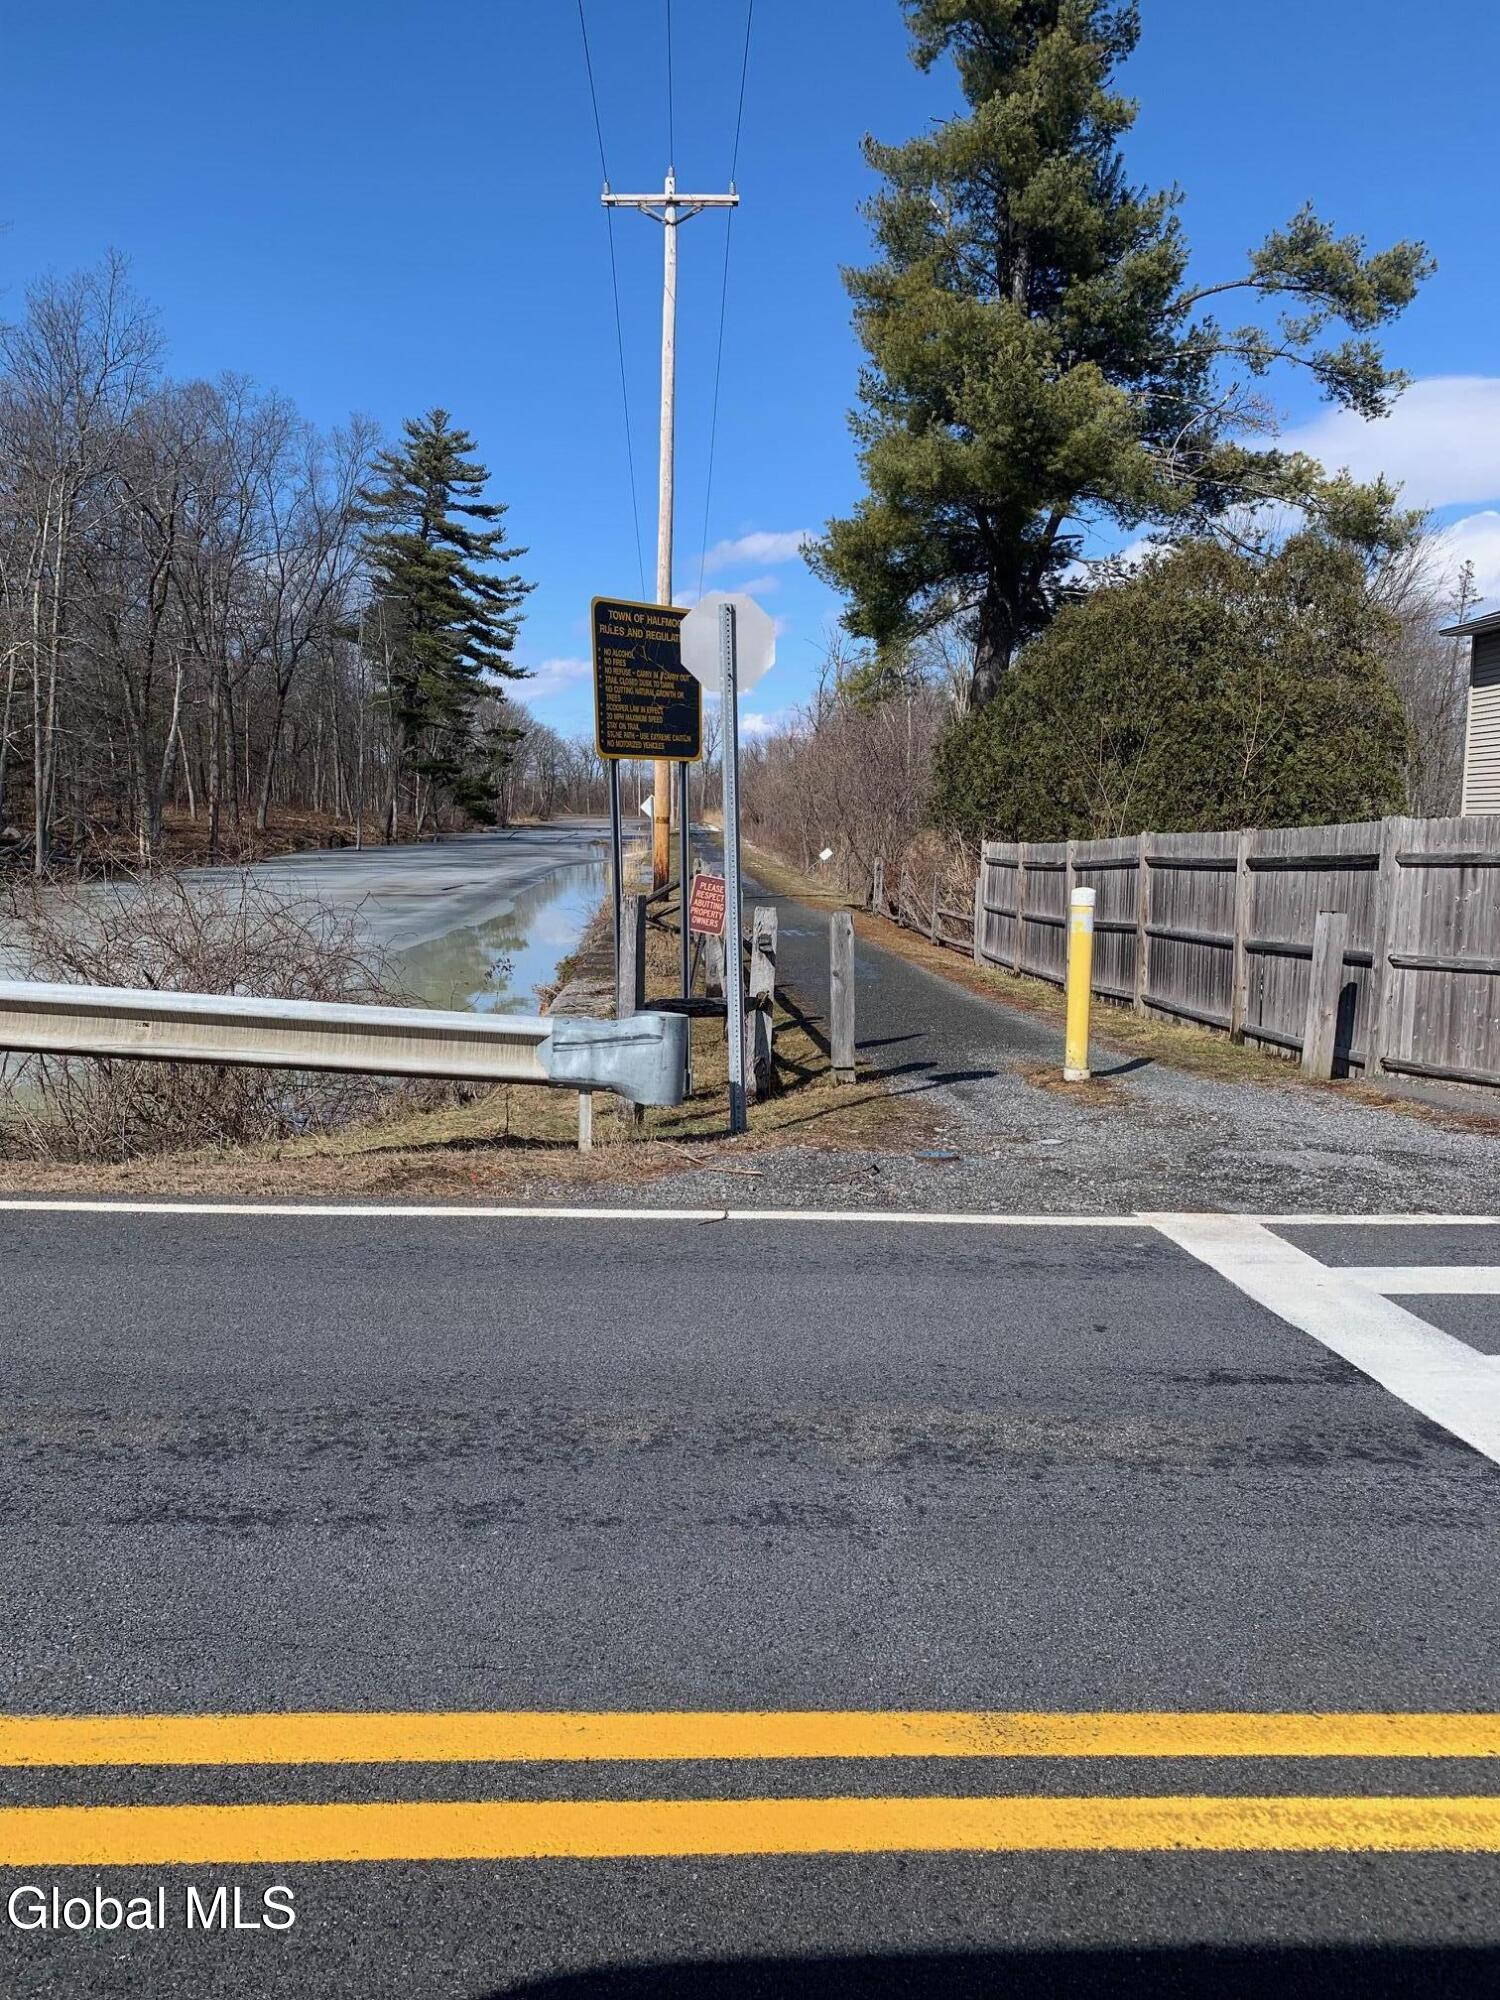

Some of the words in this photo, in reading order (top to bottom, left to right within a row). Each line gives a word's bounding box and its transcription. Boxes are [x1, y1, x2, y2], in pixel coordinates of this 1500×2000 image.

[608, 610, 631, 622] TOWN
[634, 613, 645, 623] OF
[600, 625, 624, 636] RULES
[627, 628, 643, 638] AND
[604, 648, 611, 656] NO
[612, 649, 635, 659] ALCOHOL
[613, 658, 626, 666] FIRES
[613, 668, 631, 676] REFUSE
[637, 670, 652, 678] CARRY
[664, 672, 678, 680] CARRY
[605, 676, 618, 684] TRAIL
[620, 677, 638, 685] CLOSED
[614, 686, 634, 695] CUTTING
[635, 688, 654, 696] NATURAL
[606, 704, 628, 712] SCOOPER
[647, 706, 663, 715] EFFECT
[625, 714, 647, 722] MAXIMUM
[616, 739, 642, 748] MOTORIZED
[700, 882, 724, 893] PLEASE
[696, 890, 724, 901] RESPECT
[694, 899, 724, 911] ABUTTING
[690, 907, 723, 919] PROPERTY
[692, 916, 718, 927] OWNERS
